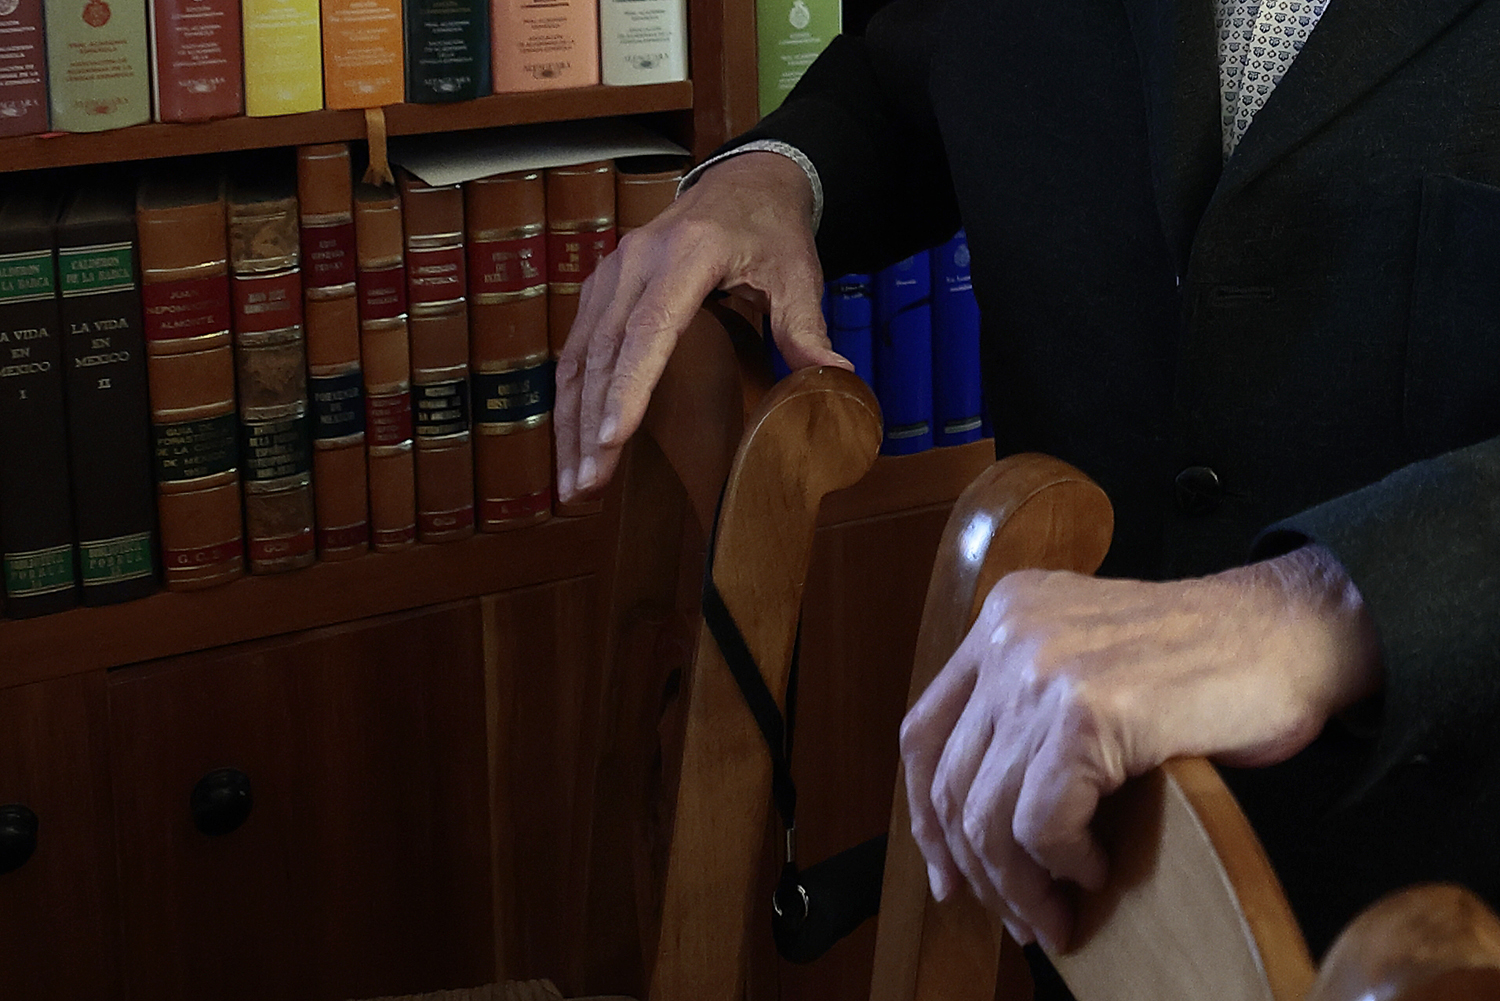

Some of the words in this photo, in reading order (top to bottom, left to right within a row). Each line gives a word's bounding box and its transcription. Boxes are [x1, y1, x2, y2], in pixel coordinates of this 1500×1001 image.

[71, 323, 91, 336] LA
[93, 317, 129, 332] VIDA
[14, 327, 49, 342] VIDA
[91, 337, 111, 350] EN
[11, 347, 30, 360] EN
[74, 350, 131, 369] MEXICO
[97, 377, 112, 390] II
[19, 388, 29, 401] I
